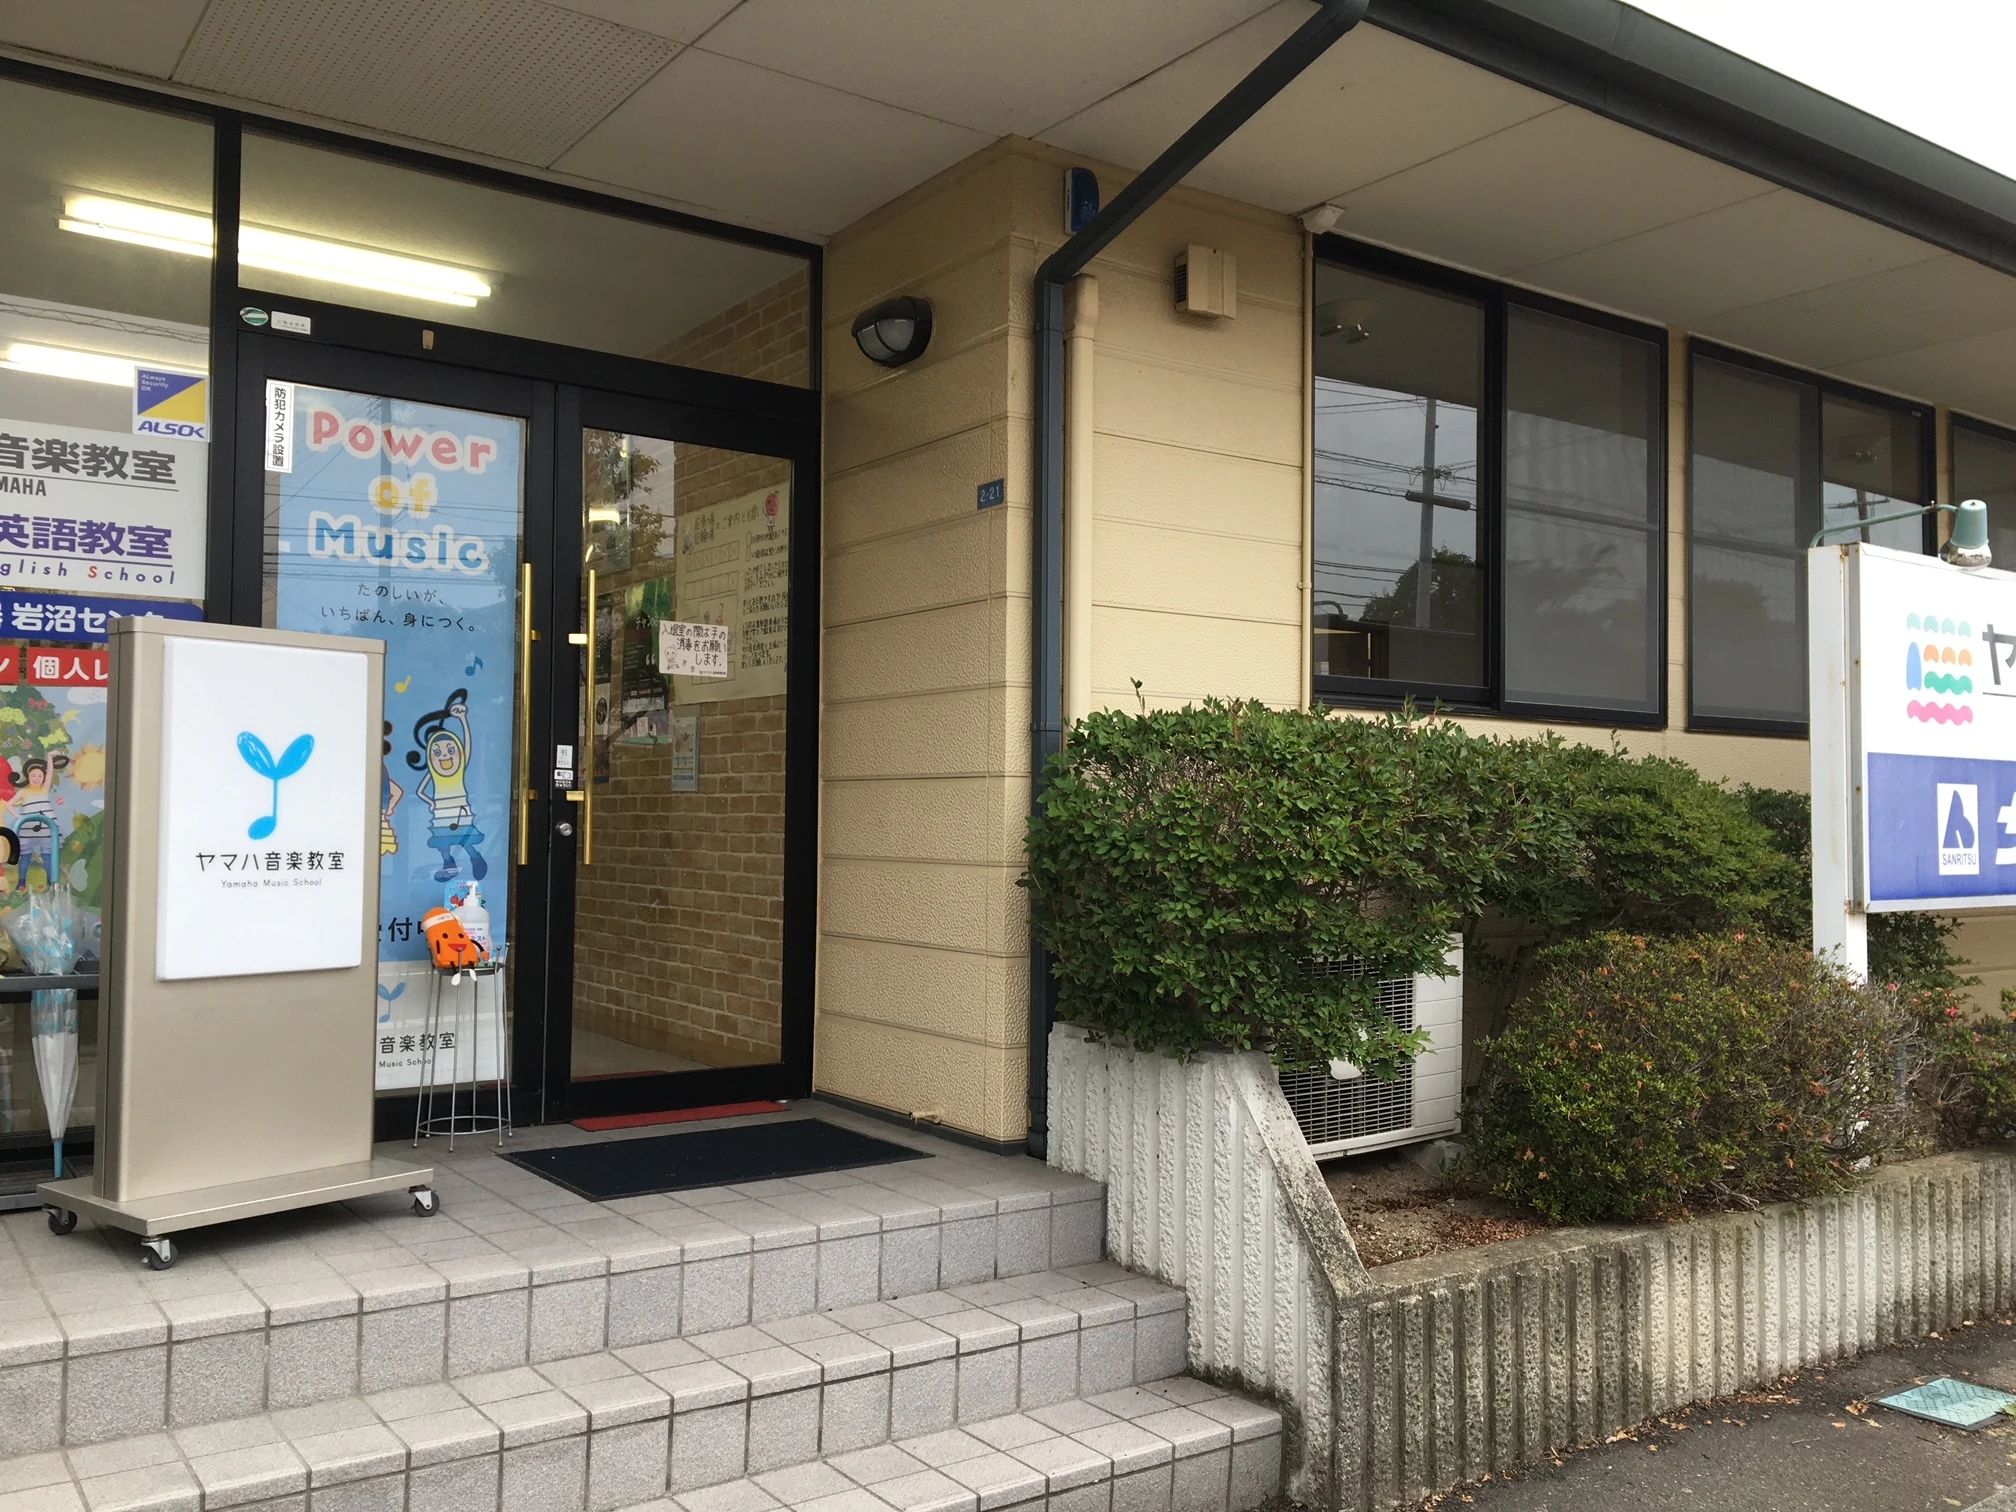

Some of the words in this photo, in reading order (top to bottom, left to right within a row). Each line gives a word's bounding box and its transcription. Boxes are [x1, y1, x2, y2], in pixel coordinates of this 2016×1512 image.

[137, 420, 205, 439] ALSOK
[272, 387, 287, 467] 防犯カメラ設置
[313, 411, 491, 469] Power
[0, 433, 176, 485] 音楽教室
[376, 479, 434, 514] of
[980, 484, 1000, 503] 2-21
[0, 513, 173, 560] 英語教室
[314, 518, 483, 570] Music
[87, 565, 176, 585] School
[357, 583, 444, 604] たのしいが、
[12, 602, 163, 633] 岩沼セ
[321, 606, 475, 632] いちばん、身につく。
[195, 851, 345, 872] ヤマハ音楽教室
[1942, 853, 1978, 867] SANRITSU
[221, 879, 259, 889] Yamaha
[263, 879, 289, 888] Music
[293, 877, 322, 887] School
[380, 1032, 456, 1054] 音楽教室
[379, 1060, 403, 1068] Music
